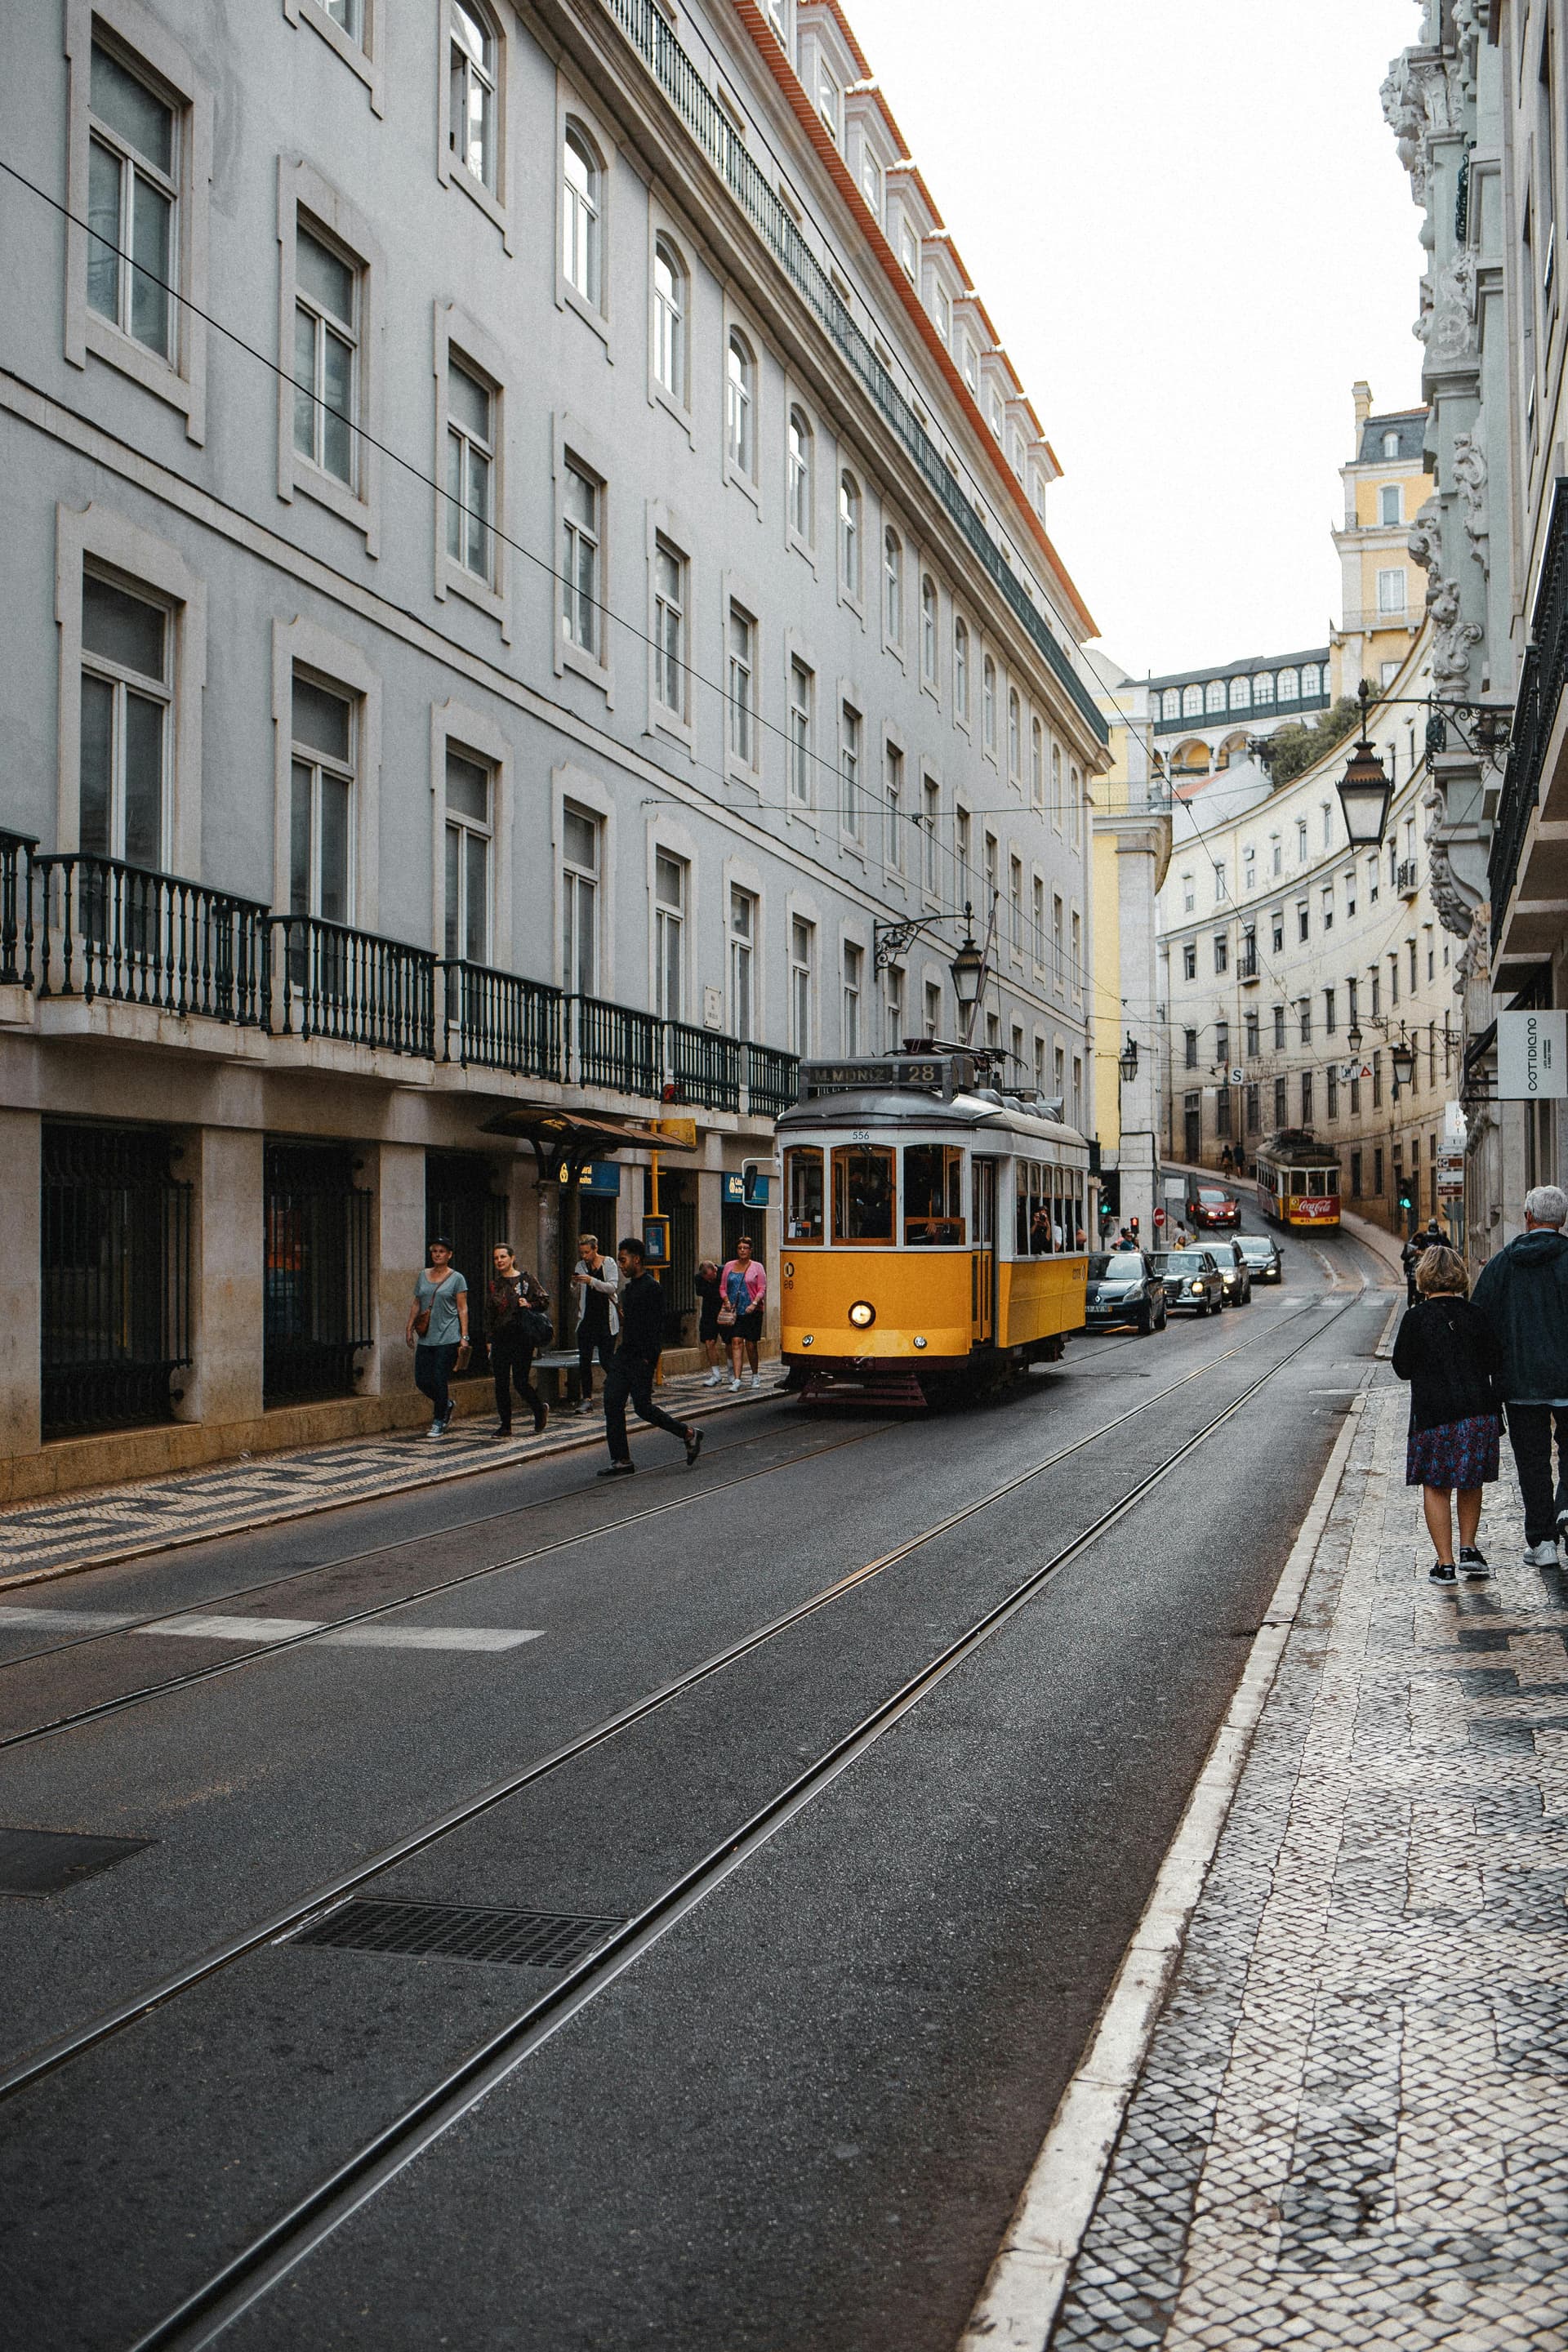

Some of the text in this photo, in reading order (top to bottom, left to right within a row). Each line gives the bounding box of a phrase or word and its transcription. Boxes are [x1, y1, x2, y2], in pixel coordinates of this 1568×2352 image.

[908, 1064, 935, 1082] 28
[1232, 1071, 1242, 1082] S
[852, 1131, 870, 1140] 556
